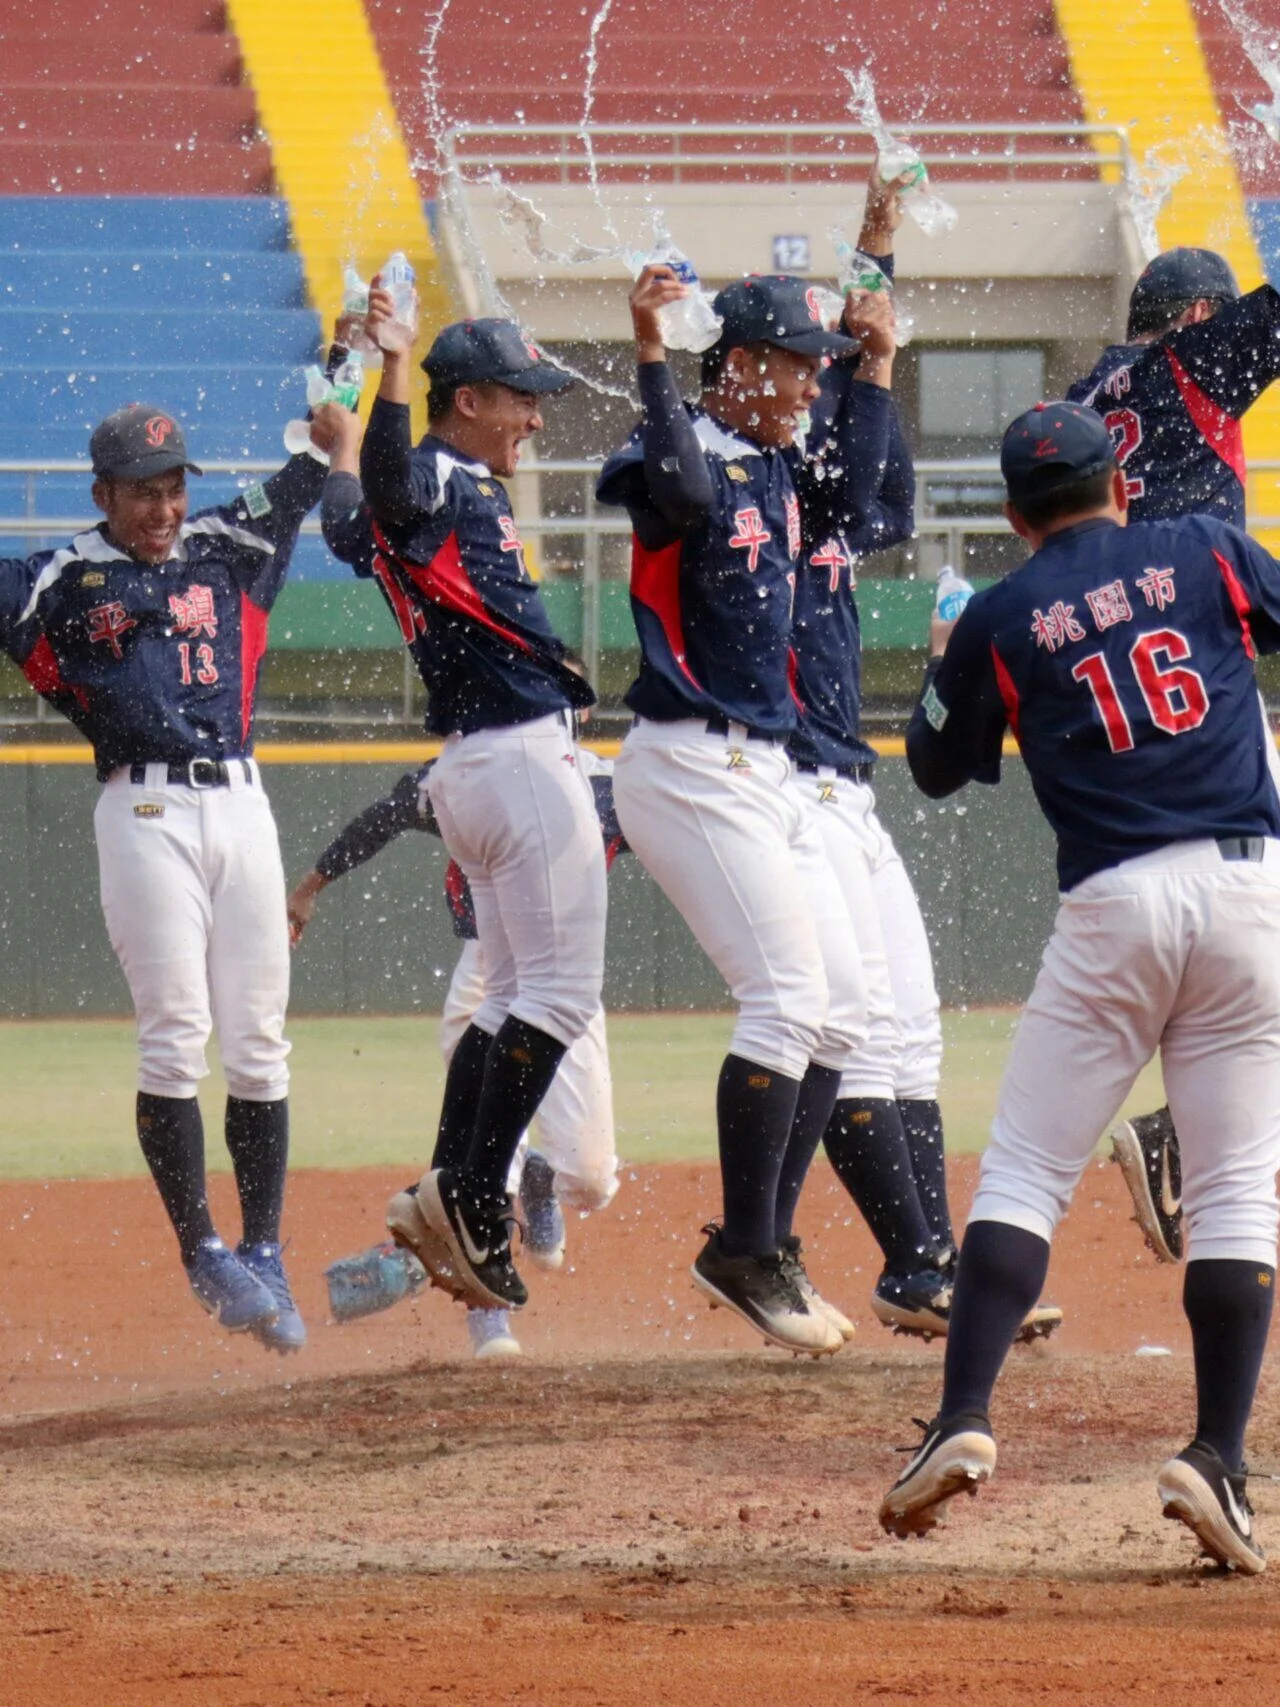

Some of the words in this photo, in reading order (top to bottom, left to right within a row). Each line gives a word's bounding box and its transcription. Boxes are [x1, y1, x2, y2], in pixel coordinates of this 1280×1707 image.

[776, 239, 807, 268] 12
[1030, 566, 1176, 653] 桃園市
[177, 642, 220, 685] 13
[1071, 627, 1211, 755] 16
